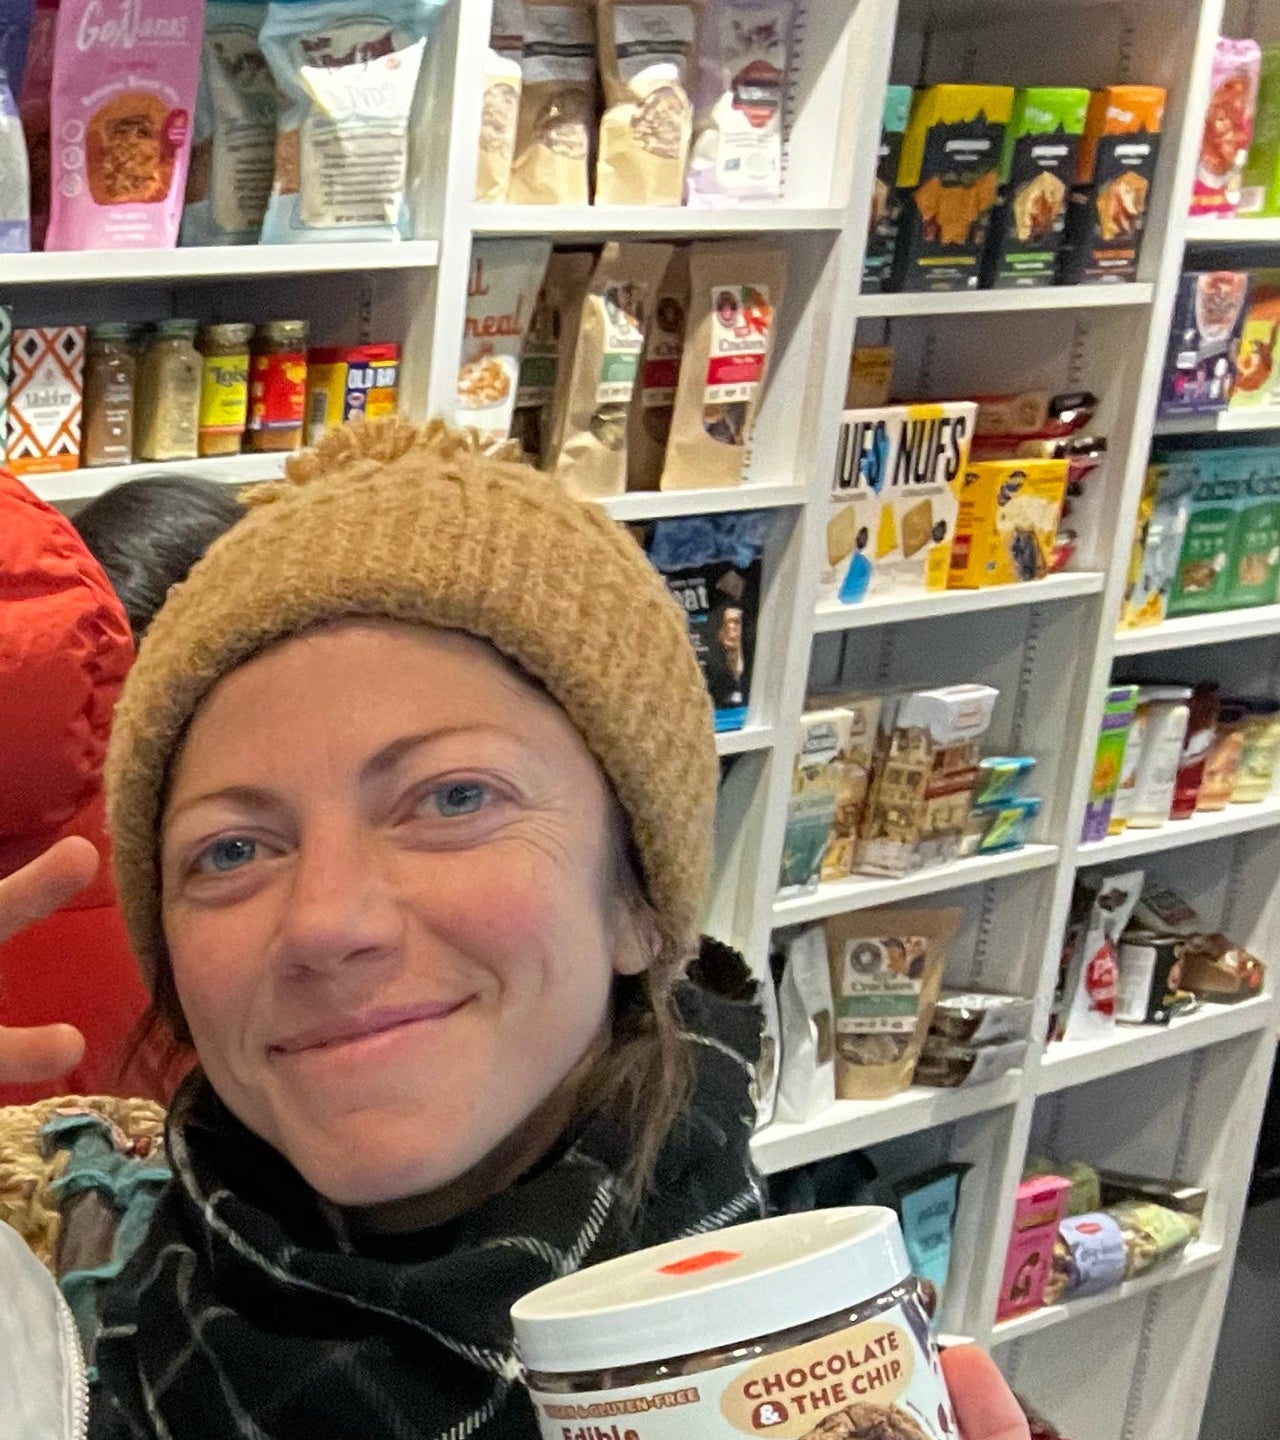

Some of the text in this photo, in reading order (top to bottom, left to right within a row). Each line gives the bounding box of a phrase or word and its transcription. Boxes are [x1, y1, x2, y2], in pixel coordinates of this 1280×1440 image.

[833, 415, 967, 490] UFS NUFS
[742, 1330, 900, 1400] CHOCOLATE
[587, 1386, 701, 1419] GLUTEN-FREE
[791, 1382, 847, 1415] THE
